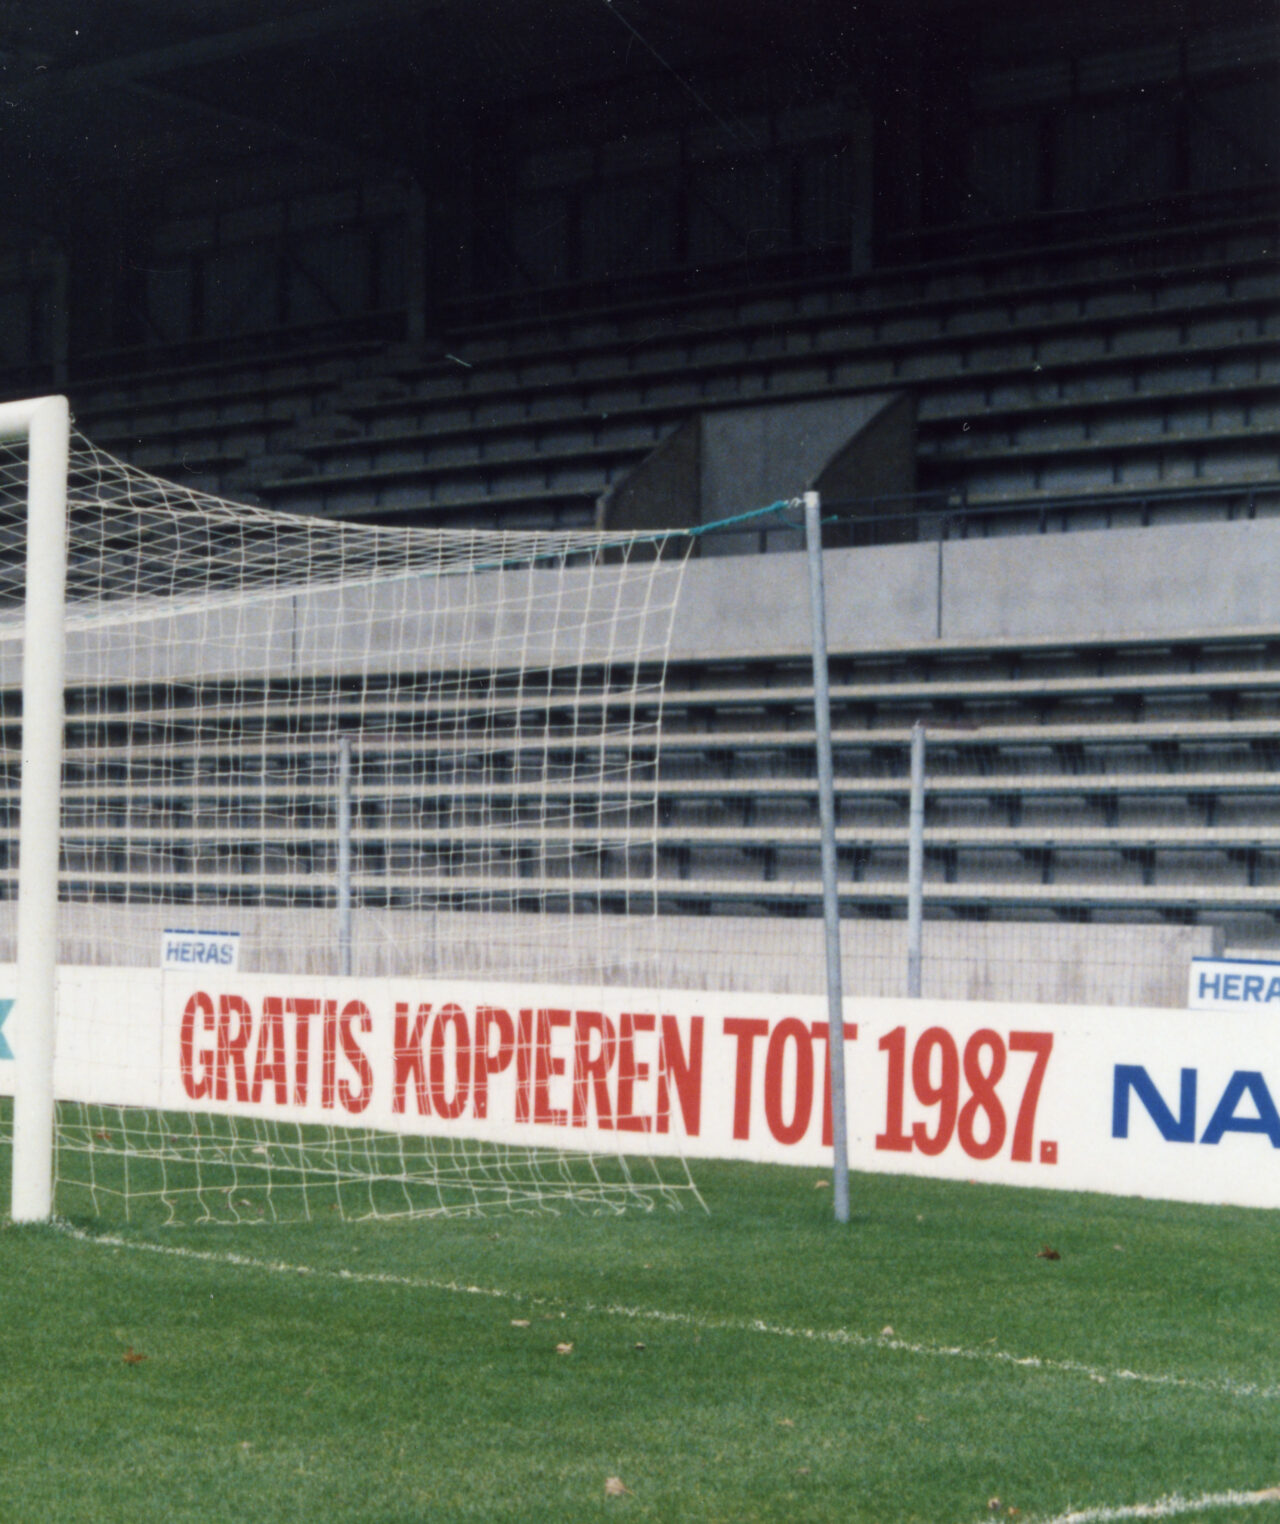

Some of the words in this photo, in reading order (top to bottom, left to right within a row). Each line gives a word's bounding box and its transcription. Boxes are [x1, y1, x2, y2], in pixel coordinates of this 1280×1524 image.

[166, 941, 233, 965] HERAS
[179, 990, 373, 1115] GRATIS
[393, 1001, 705, 1137] KOPIEREN
[723, 1016, 859, 1147] TOT
[875, 1025, 1058, 1165] 1987.
